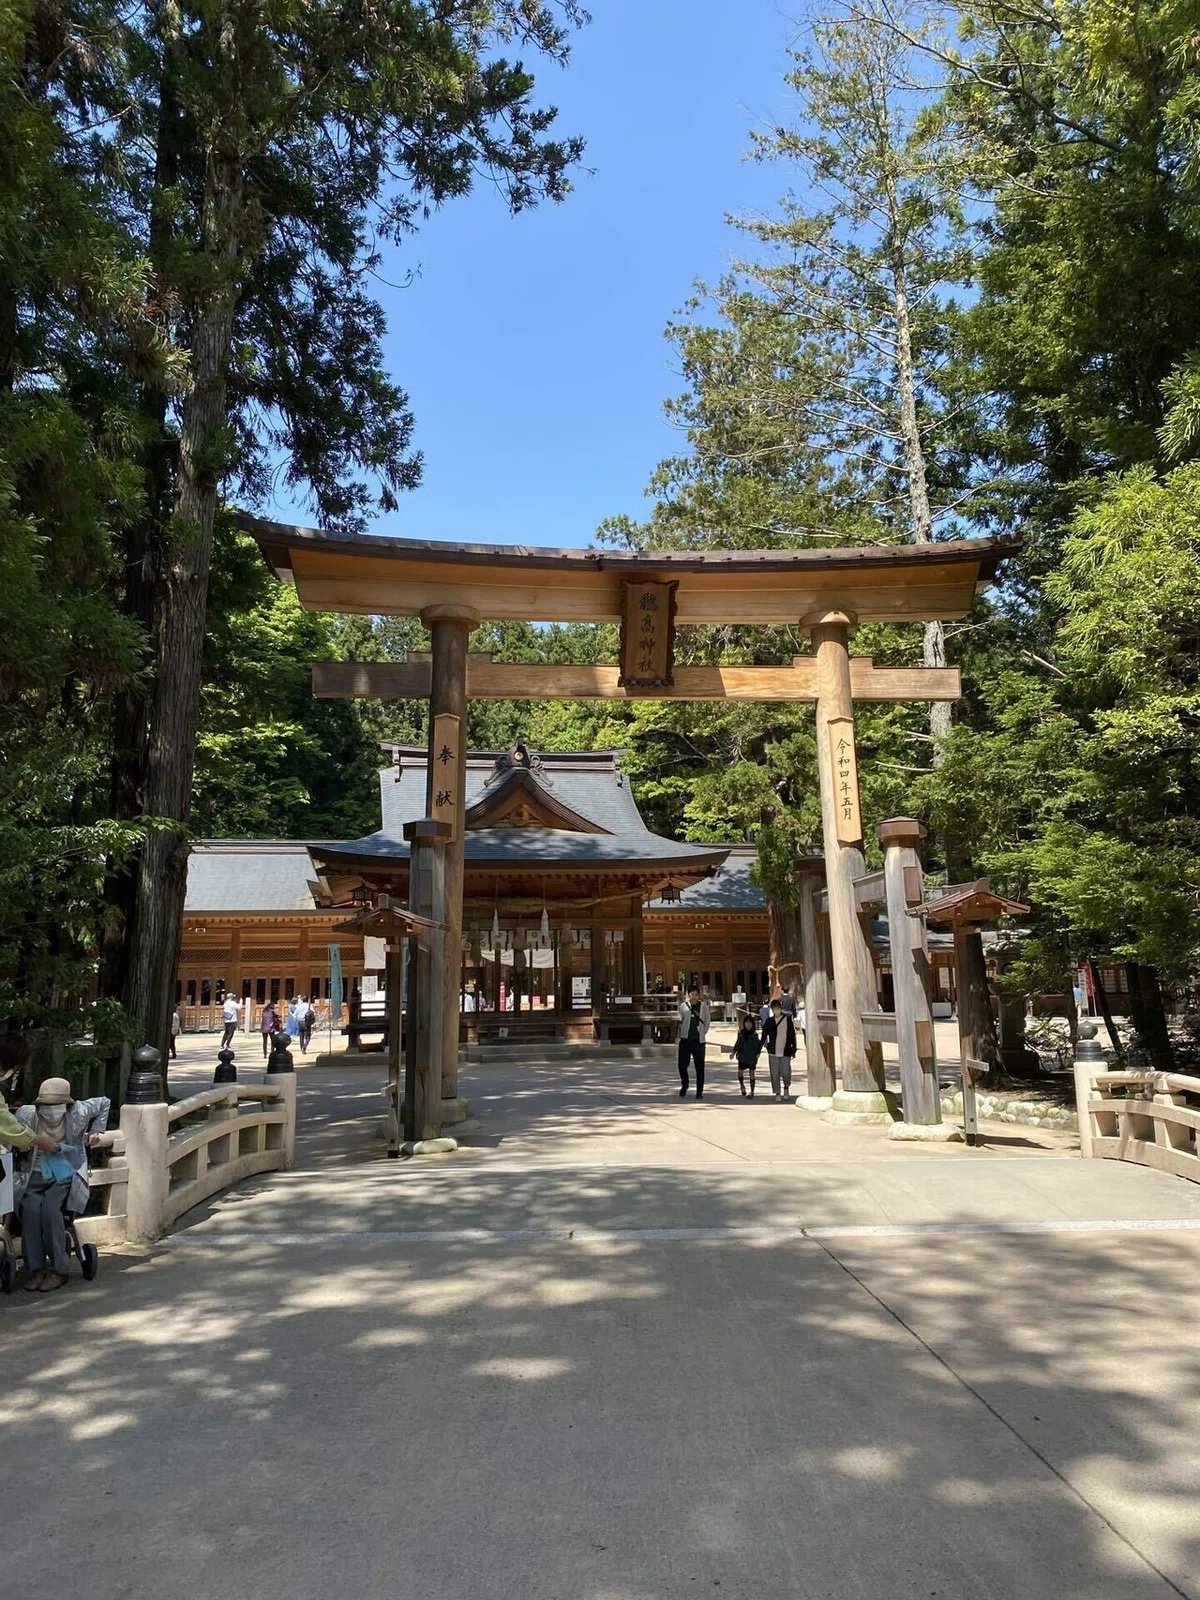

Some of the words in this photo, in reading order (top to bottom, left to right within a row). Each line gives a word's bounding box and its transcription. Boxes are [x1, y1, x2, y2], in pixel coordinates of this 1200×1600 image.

[435, 744, 457, 807] 奉献
[836, 738, 853, 820] 令和四年五月
